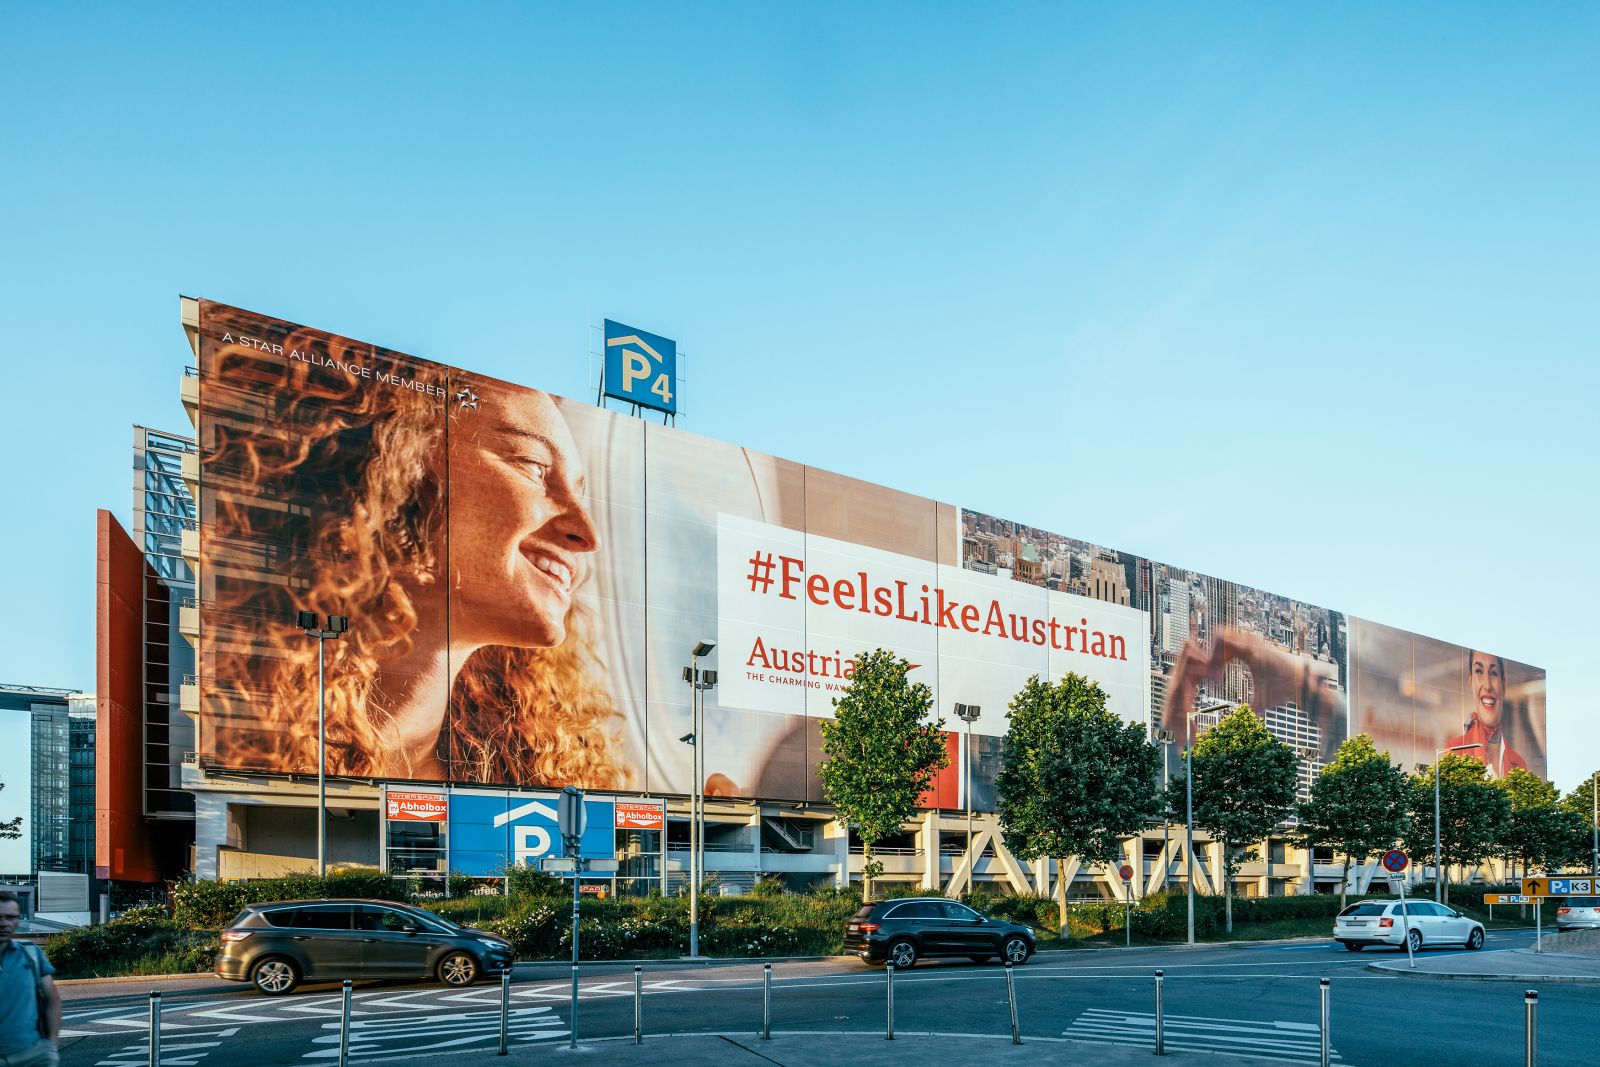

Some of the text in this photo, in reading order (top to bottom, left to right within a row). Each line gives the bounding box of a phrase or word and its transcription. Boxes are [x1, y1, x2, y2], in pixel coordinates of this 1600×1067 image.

[222, 332, 446, 398] A STAR ALLIANCE MEMBER
[747, 550, 1128, 661] #FeelsLikeAustrian
[746, 636, 858, 681] Austria
[746, 672, 765, 682] THE
[769, 675, 820, 689] CHARMING
[400, 802, 447, 811] Abholbox
[626, 812, 662, 821] Abholbox
[468, 885, 500, 896] ufen.
[1571, 883, 1589, 891] K3
